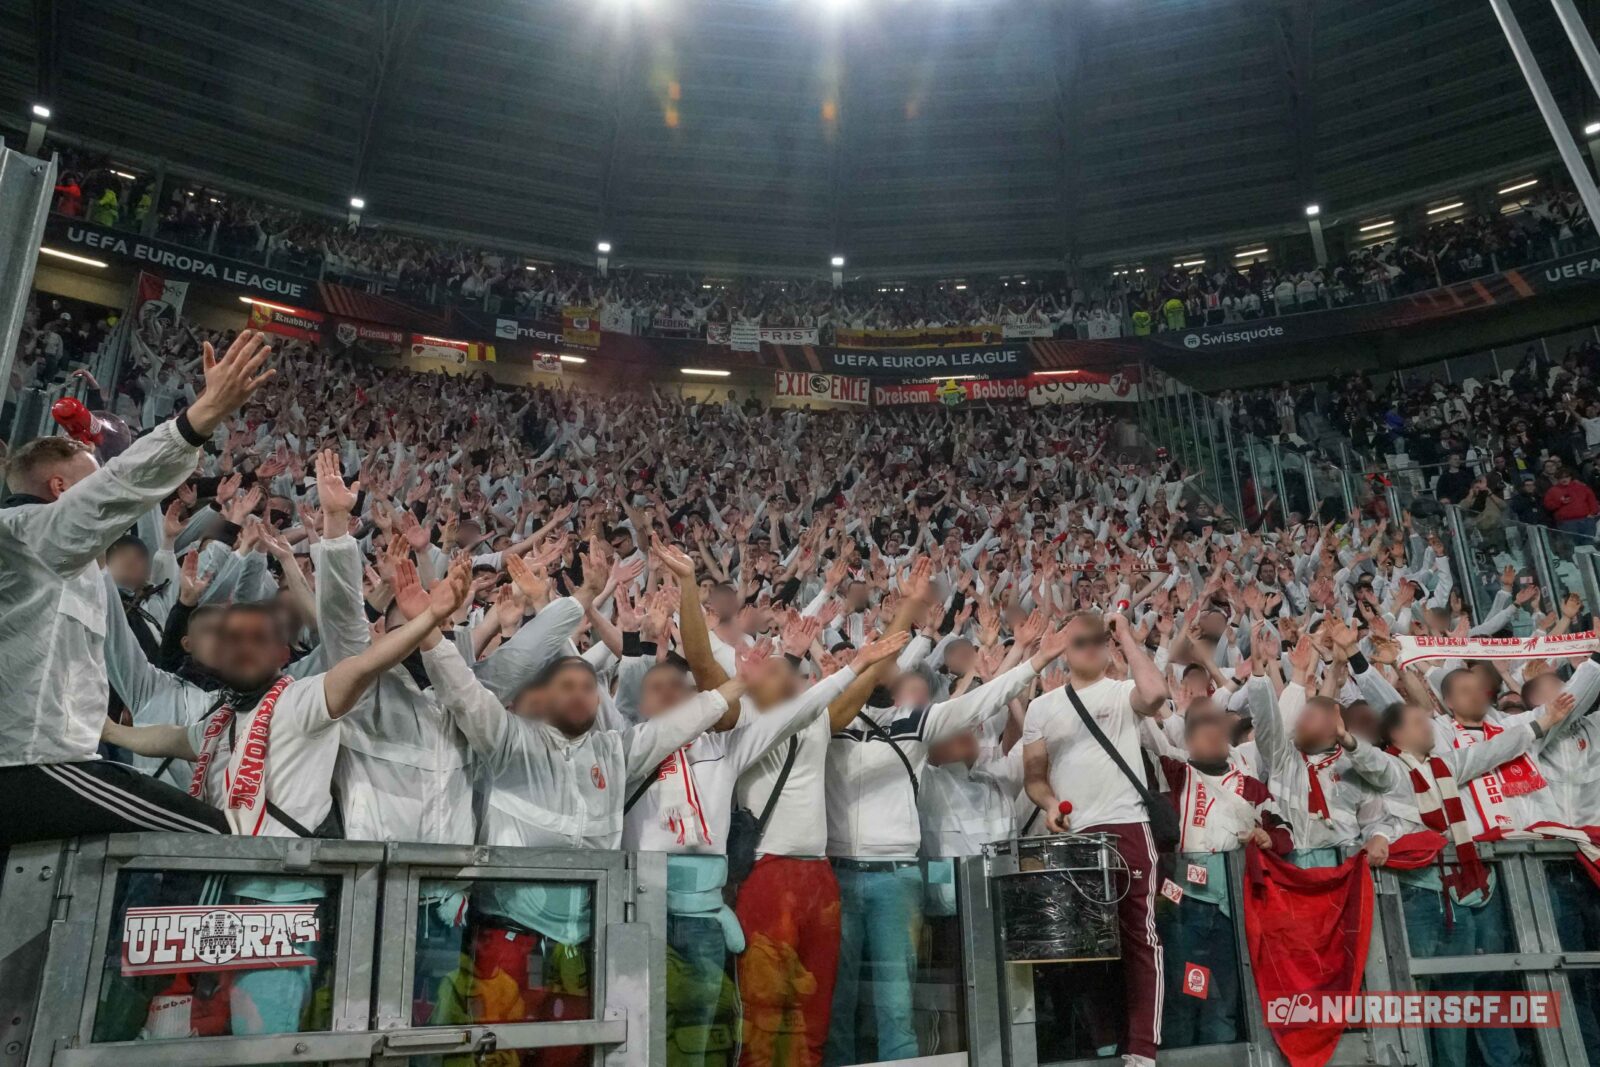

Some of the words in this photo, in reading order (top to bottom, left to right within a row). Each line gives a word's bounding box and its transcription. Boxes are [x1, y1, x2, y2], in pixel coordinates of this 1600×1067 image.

[67, 226, 128, 255] UEFA
[133, 244, 218, 278] EUROPA
[222, 267, 302, 297] LEAGUE
[1545, 257, 1600, 282] UEFA
[500, 324, 565, 344] enterp
[1201, 325, 1284, 346] Swissquote
[834, 354, 879, 367] UEFA
[882, 354, 948, 368] EUROPA
[951, 350, 1018, 366] LEAGUE
[874, 385, 931, 406] Dreisam
[972, 380, 1027, 400] Bobbele
[1131, 563, 1160, 571] LUB
[127, 914, 319, 965] ULTRAS
